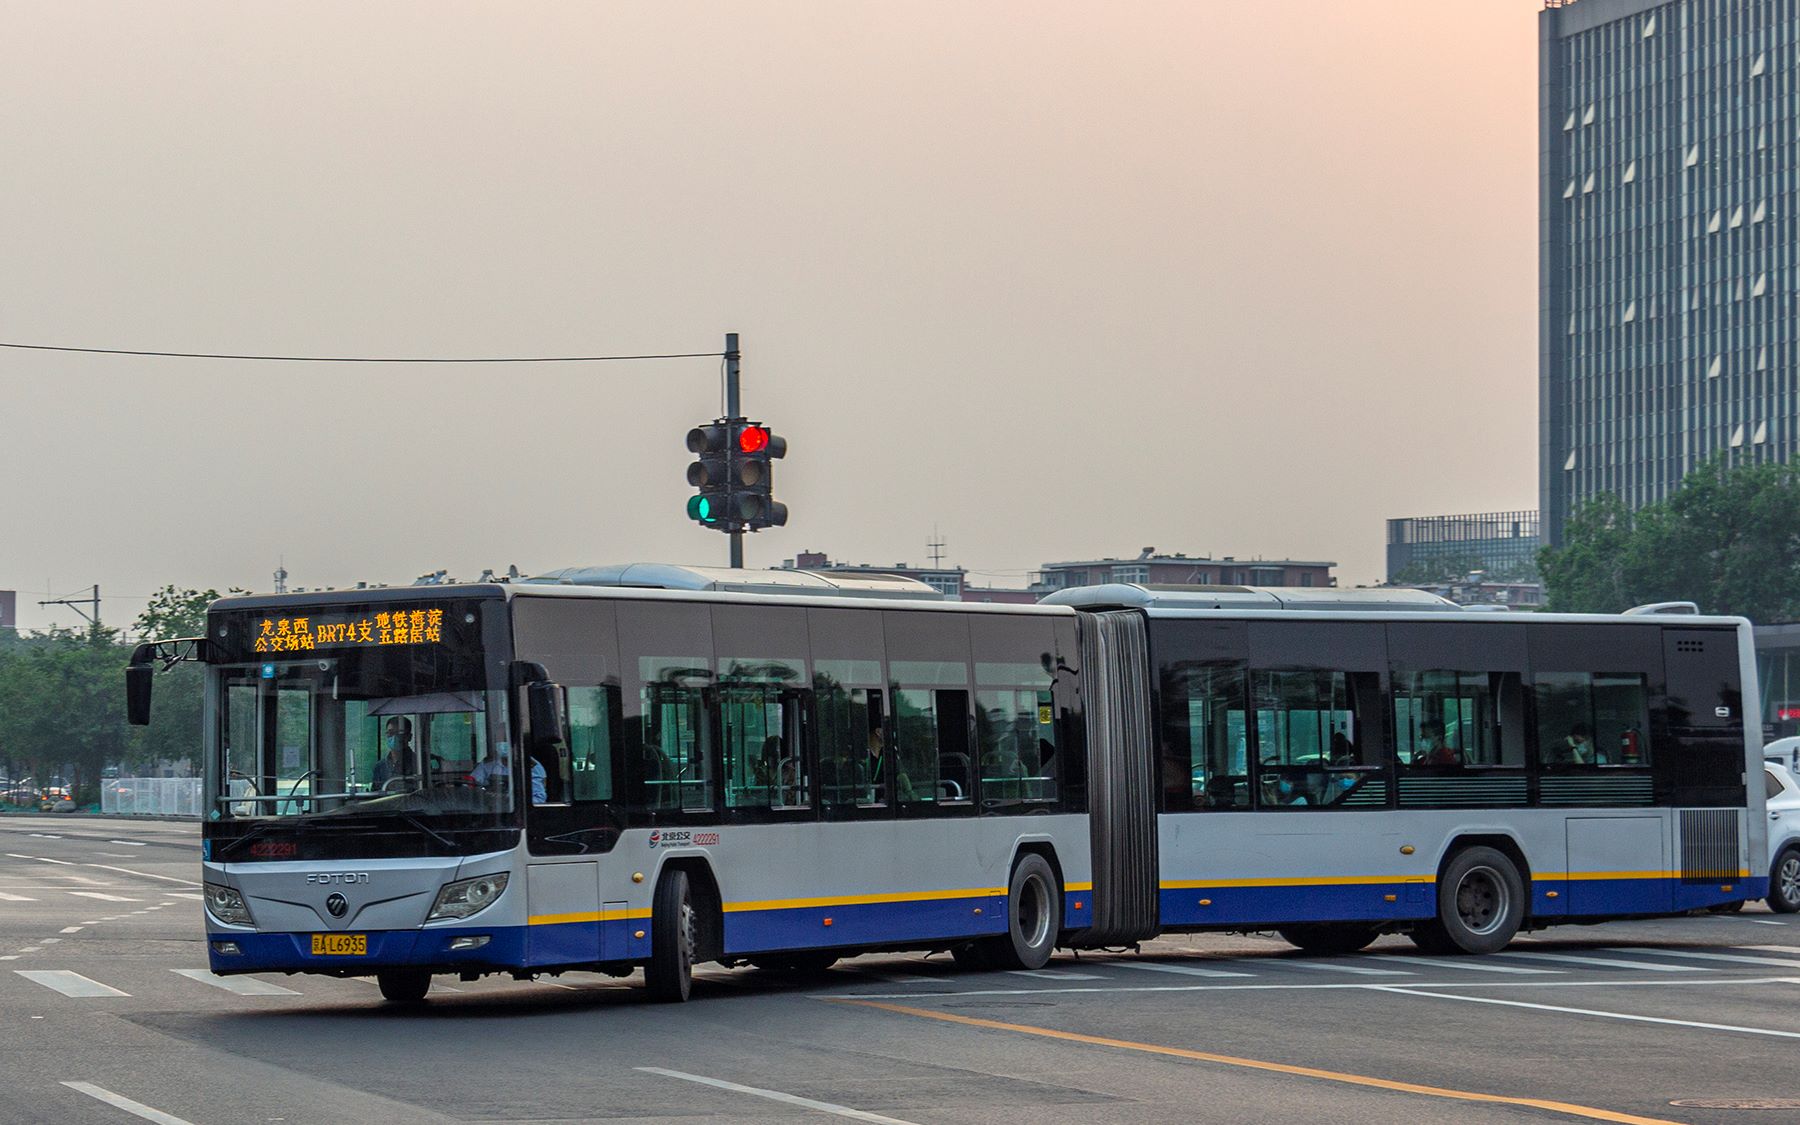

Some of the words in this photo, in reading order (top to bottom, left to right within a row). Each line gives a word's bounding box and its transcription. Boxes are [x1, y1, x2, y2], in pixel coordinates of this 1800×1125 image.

[259, 617, 310, 636] 龙泉西
[317, 619, 374, 643] BRT4支
[254, 632, 315, 653] 公交场站
[306, 872, 370, 885] FOTON
